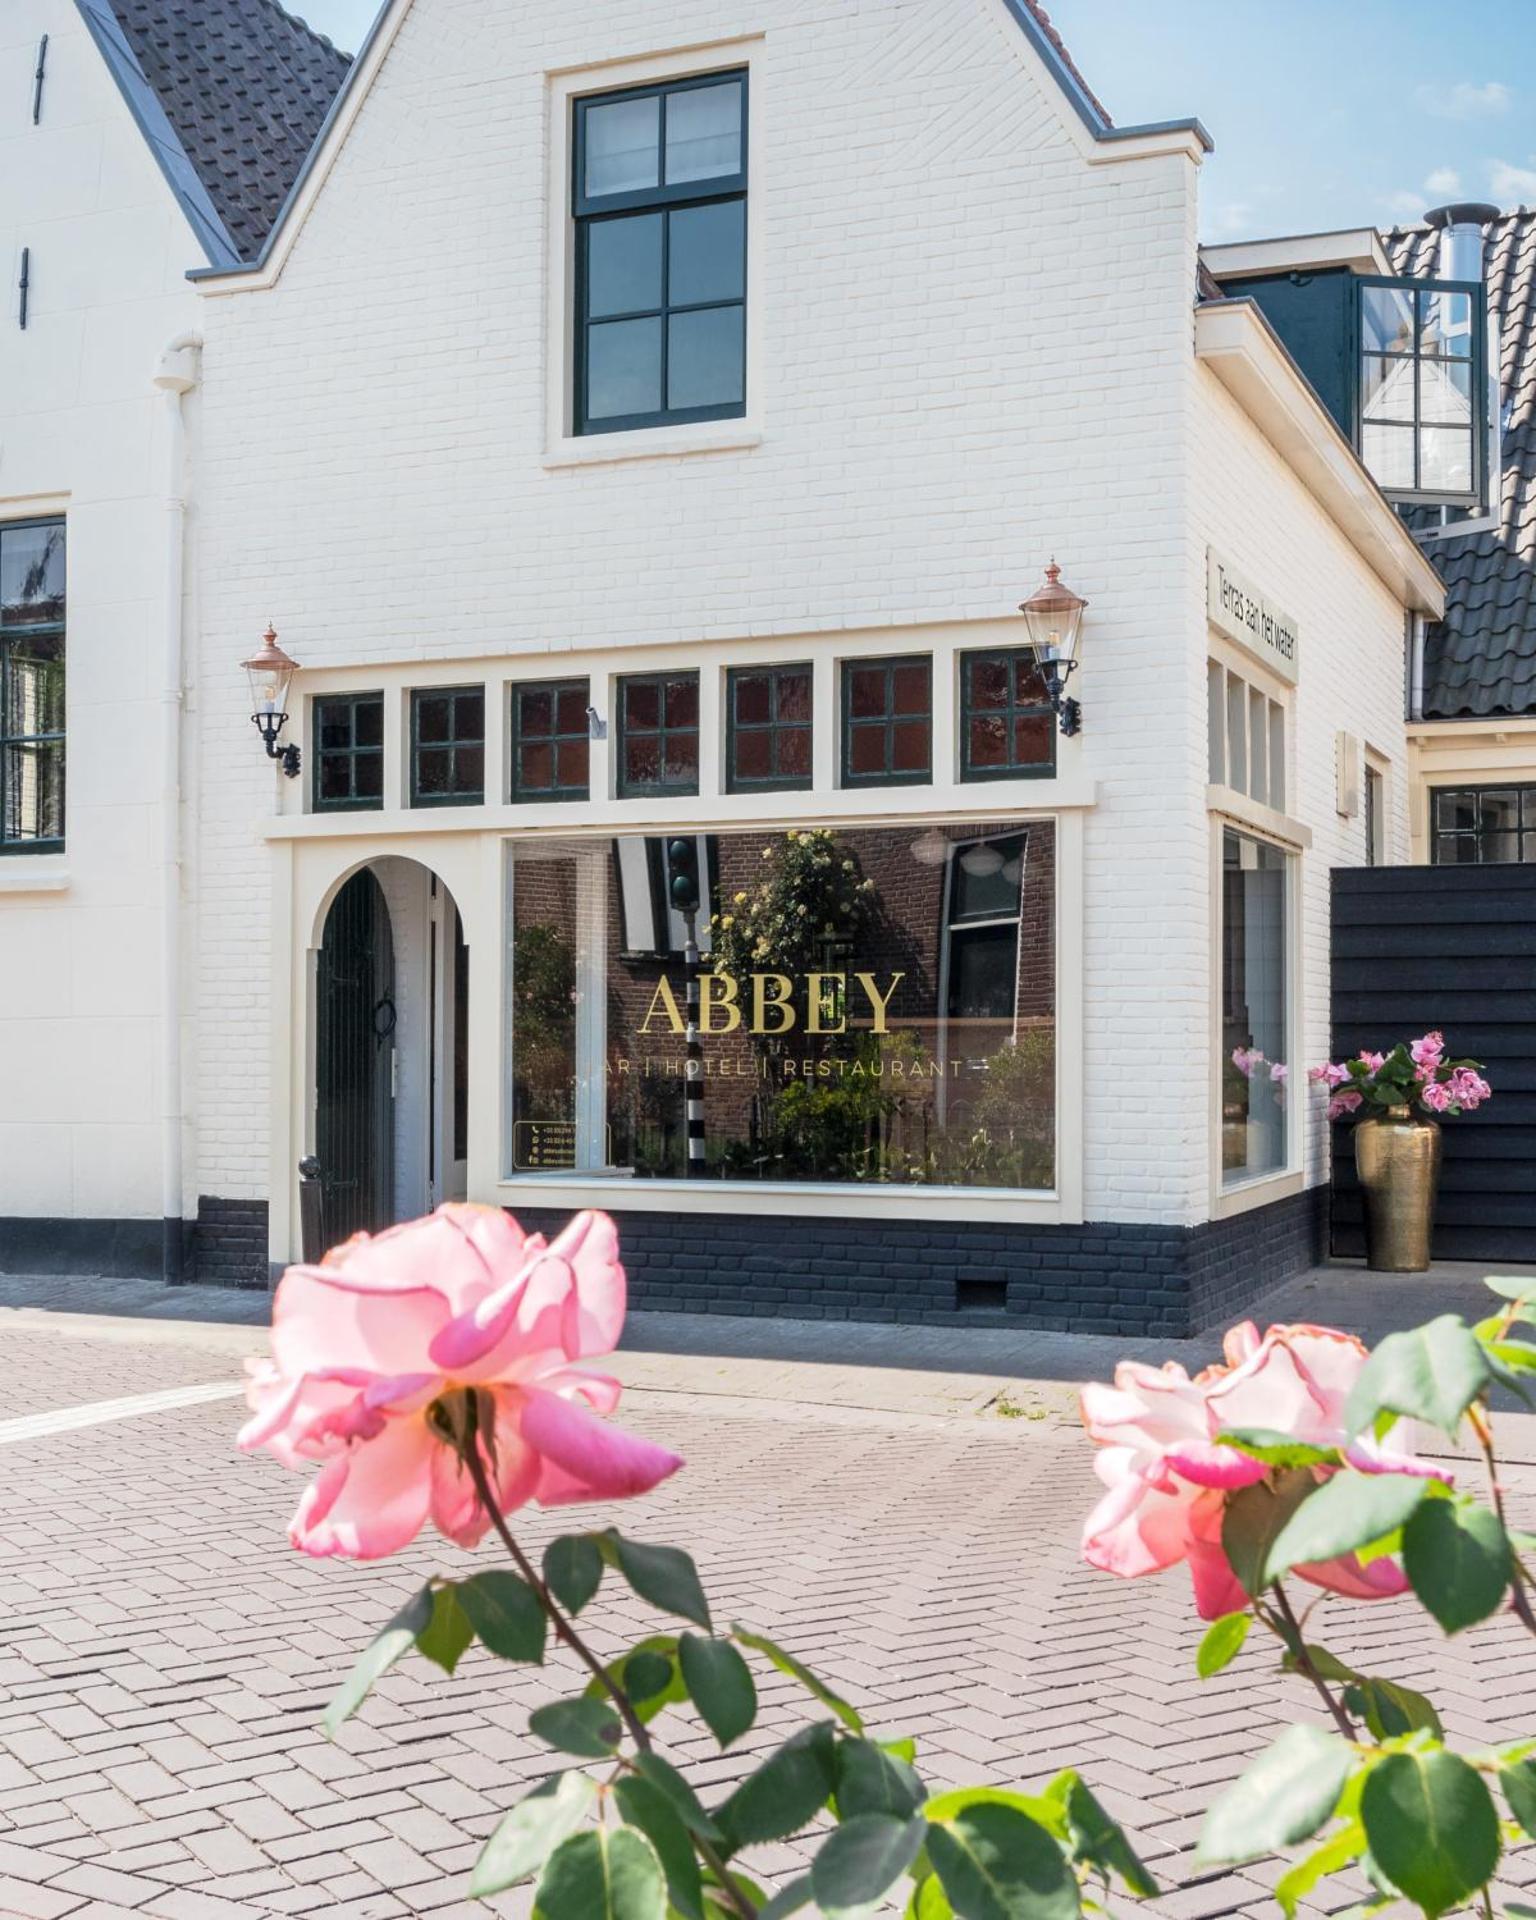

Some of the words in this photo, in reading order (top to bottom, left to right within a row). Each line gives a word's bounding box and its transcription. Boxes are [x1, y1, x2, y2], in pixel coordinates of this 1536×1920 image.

[1217, 564, 1244, 621] Terras
[1245, 598, 1260, 635] aan
[1261, 600, 1273, 646] het
[1274, 622, 1294, 661] water
[637, 972, 905, 1034] ABBEY
[601, 1059, 630, 1075] AR
[666, 1059, 747, 1076] HOTEL
[783, 1059, 962, 1077] RESTAURANT
